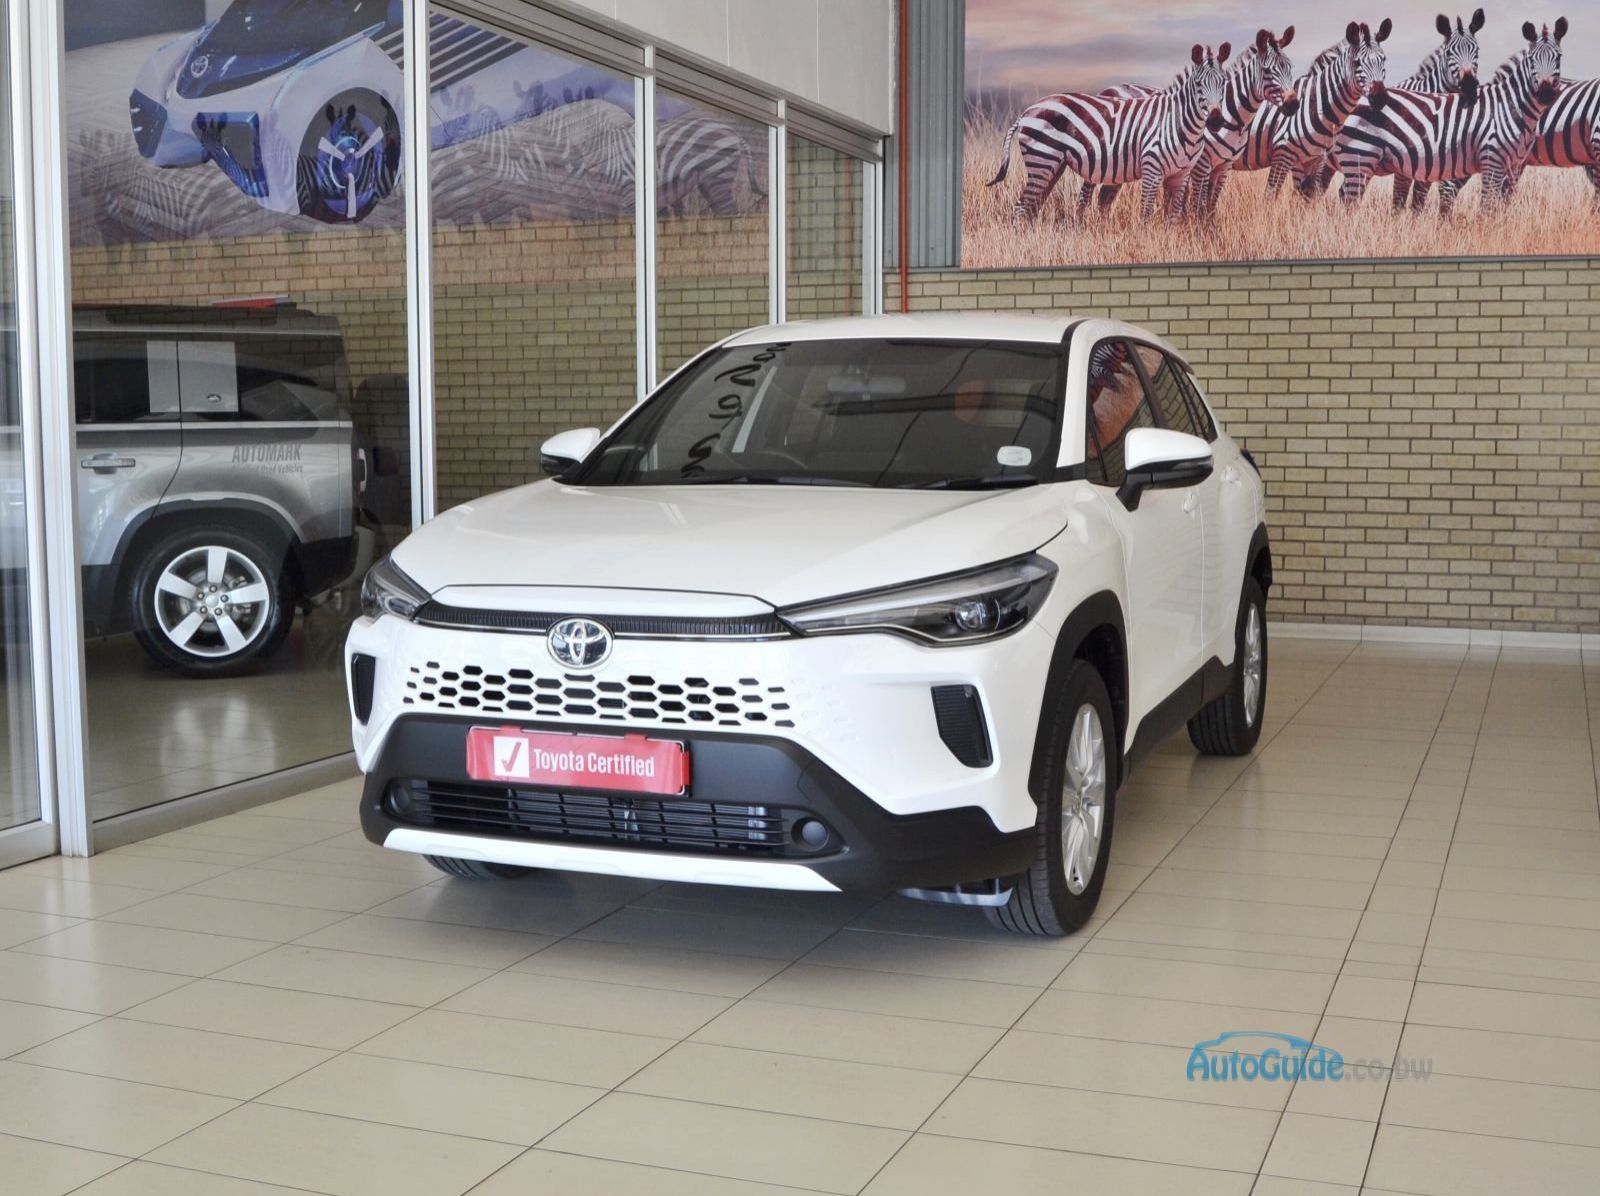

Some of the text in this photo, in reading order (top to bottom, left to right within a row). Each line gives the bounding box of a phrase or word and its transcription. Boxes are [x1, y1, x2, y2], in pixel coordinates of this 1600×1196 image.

[231, 443, 302, 463] AUTOMARK
[534, 748, 655, 777] Toyota Certified
